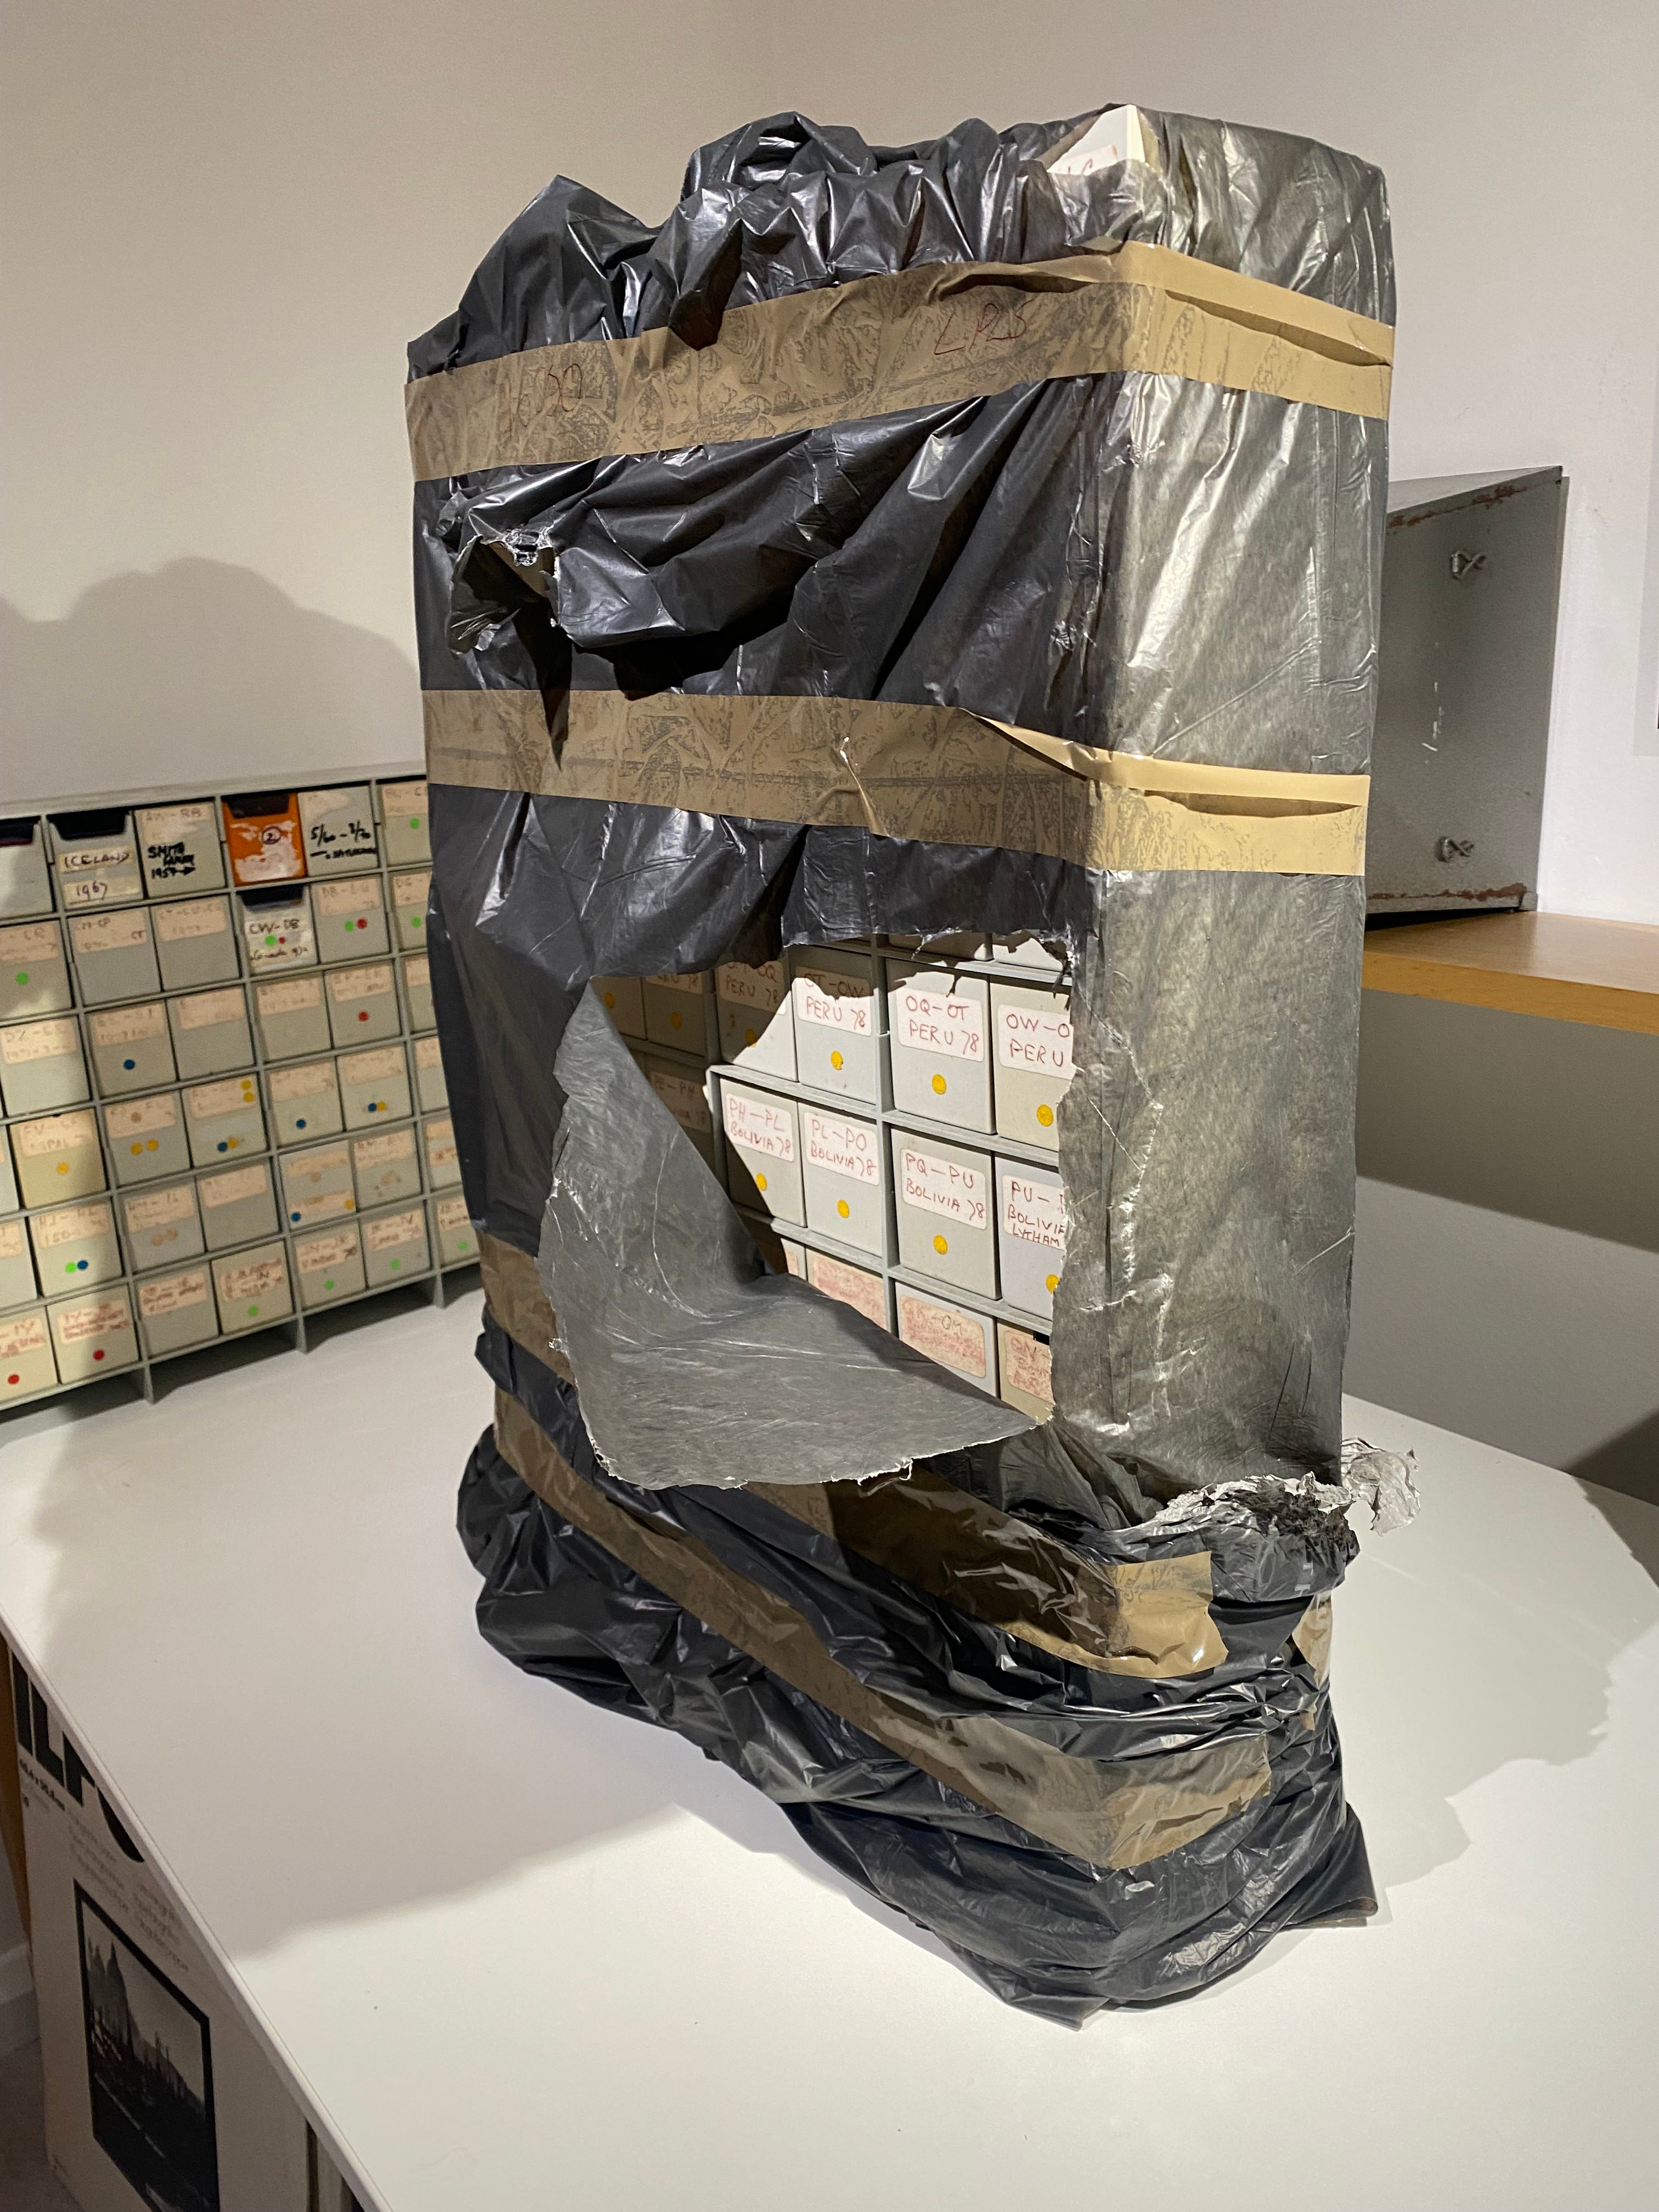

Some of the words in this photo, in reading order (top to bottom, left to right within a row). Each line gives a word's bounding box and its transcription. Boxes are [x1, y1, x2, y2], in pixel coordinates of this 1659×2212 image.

[64, 852, 129, 867] ICELAND
[76, 880, 108, 900] 1967
[725, 974, 755, 997] PERU
[806, 996, 842, 1022] PERU
[850, 1009, 865, 1030] 78
[909, 1019, 953, 1046] PERU
[961, 1030, 979, 1055] 78
[1009, 1037, 1064, 1068] PERU
[730, 1121, 774, 1151] BOLIVIA
[776, 1137, 792, 1157] 78
[810, 1141, 855, 1170] BOLIVIA
[856, 1156, 878, 1177] 78
[906, 1177, 961, 1213] BOLIVIA
[967, 1199, 985, 1221] 78
[1012, 1222, 1060, 1248] LYTHAM
